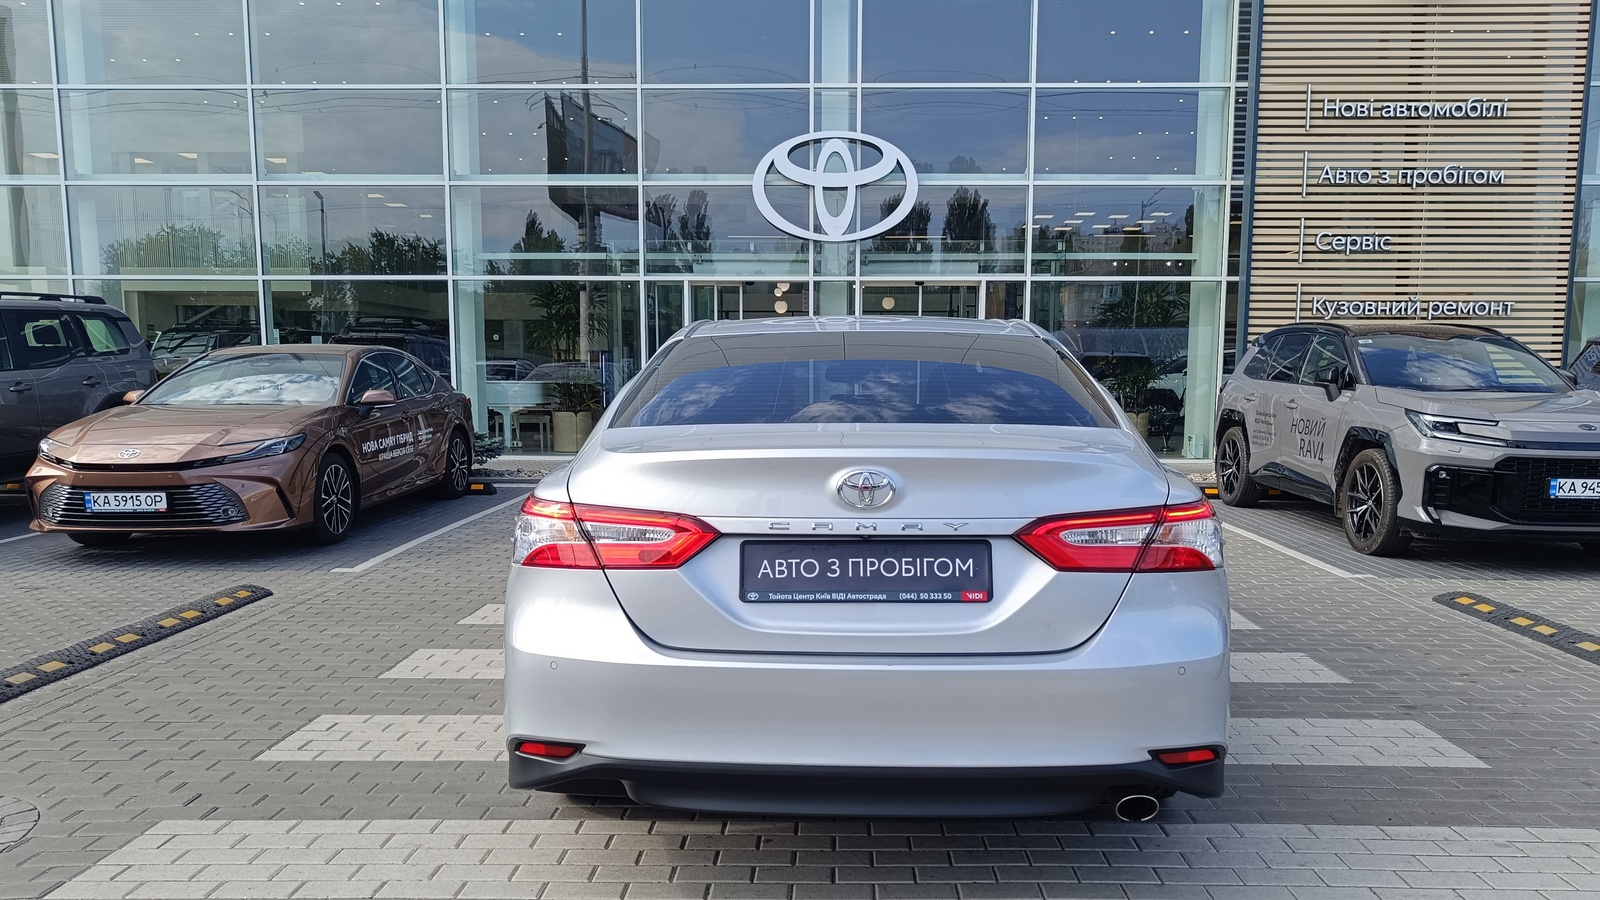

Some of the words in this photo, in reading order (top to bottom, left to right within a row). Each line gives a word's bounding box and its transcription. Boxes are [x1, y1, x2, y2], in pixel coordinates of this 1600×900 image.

[1323, 97, 1375, 117] Нові
[1381, 97, 1509, 118] автомобілі
[1318, 164, 1372, 185] Авто
[1378, 169, 1390, 185] з
[1397, 164, 1505, 189] пробігом
[1315, 231, 1392, 255] Сервіс
[1312, 296, 1421, 320] Кузовний
[1428, 300, 1515, 320] ремонт
[1290, 417, 1326, 438] НОВИЙ
[362, 440, 379, 454] НОВА
[378, 435, 396, 449] CAMRY
[1299, 438, 1324, 464] RAV4
[1557, 481, 1577, 494] KA
[92, 495, 111, 507] KA
[114, 495, 142, 507] 5915
[145, 495, 163, 507] OP
[768, 521, 969, 531] CAMRY
[757, 558, 820, 578] АВТО
[827, 558, 840, 577] З
[848, 557, 974, 577] ПРОБІГОМ
[768, 592, 792, 600] Тойота
[793, 593, 814, 601] Центр
[816, 592, 831, 600] Київ
[832, 593, 846, 601] ВІДІ
[847, 593, 887, 601] Автострада
[899, 592, 918, 600] (044)
[966, 592, 983, 600] VIDI
